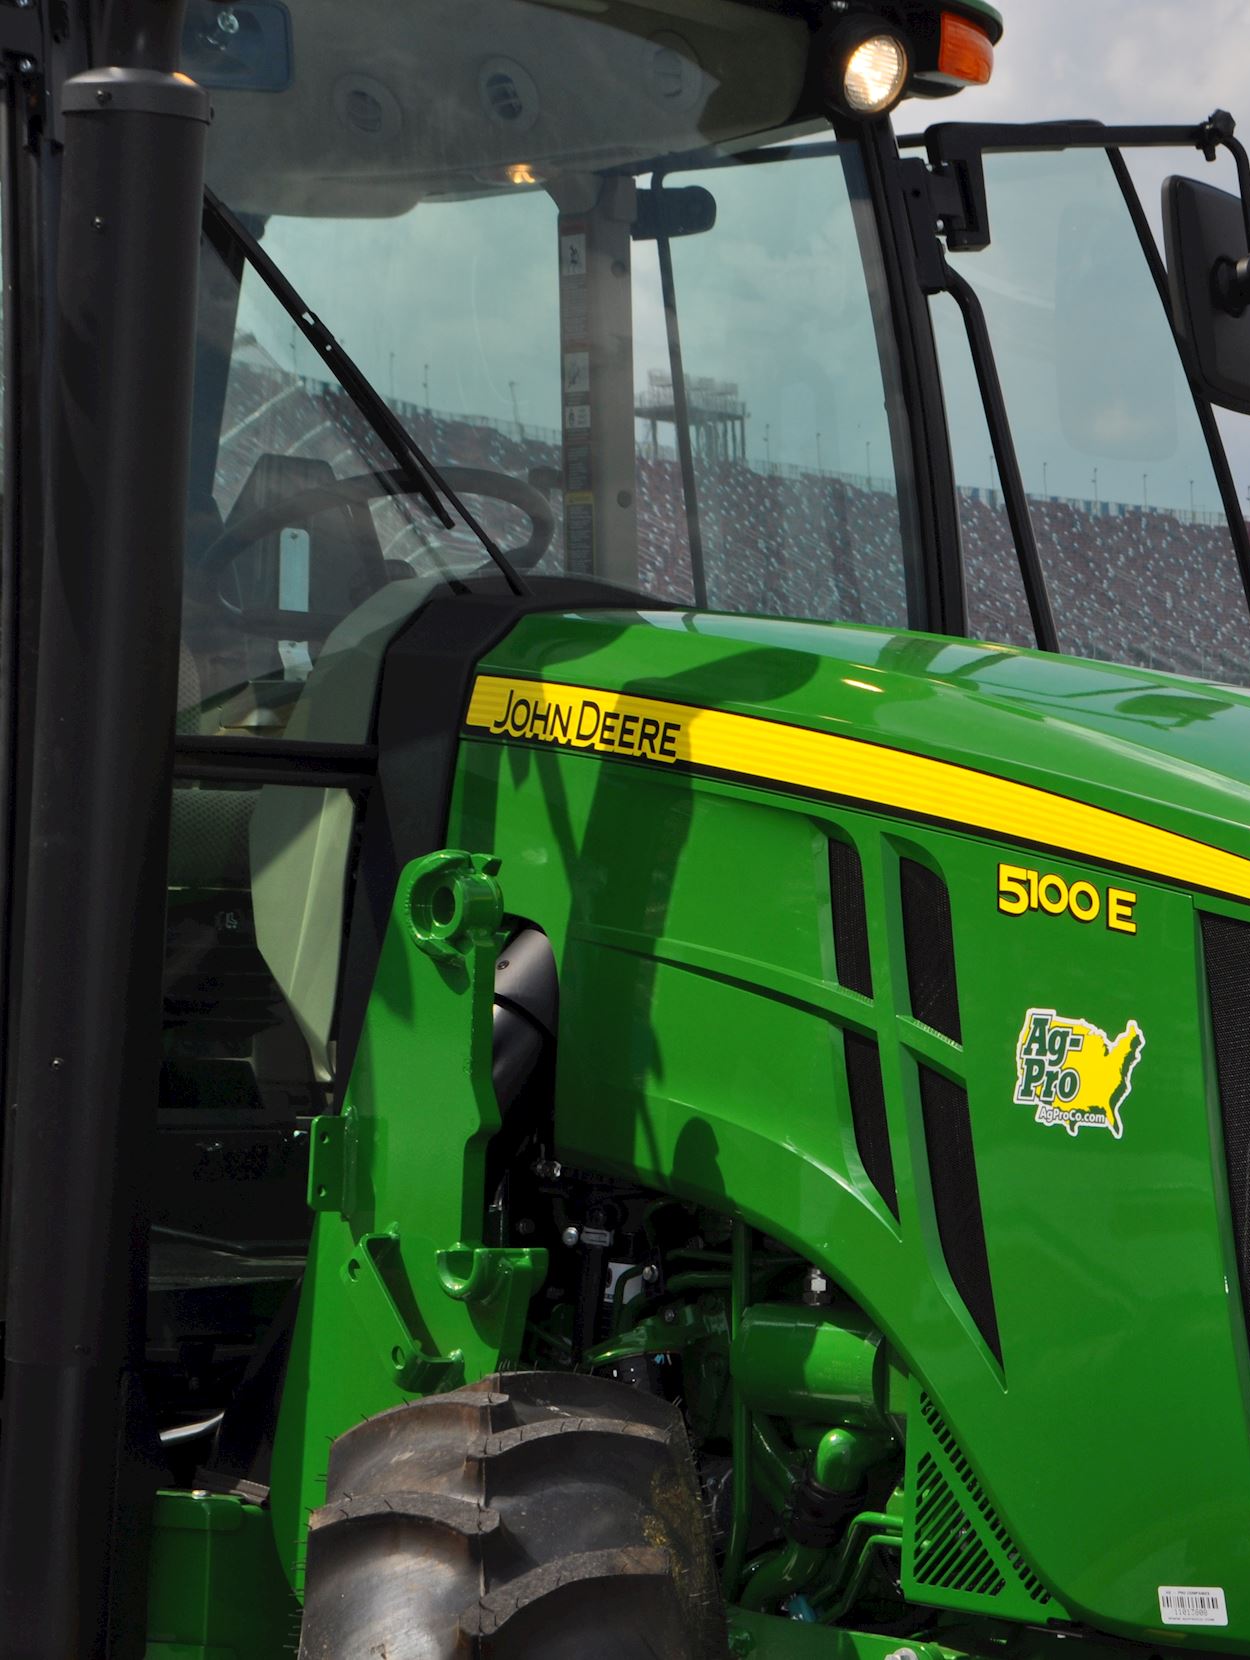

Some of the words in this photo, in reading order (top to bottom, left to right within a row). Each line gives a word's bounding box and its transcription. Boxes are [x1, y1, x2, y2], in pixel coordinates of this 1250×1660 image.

[494, 689, 572, 738] JOHN
[576, 699, 682, 758] DEERE
[998, 863, 1100, 924] 5100
[1107, 886, 1137, 936] E
[1021, 1015, 1082, 1066] Ag-
[1019, 1058, 1080, 1101] Pro
[1038, 1106, 1106, 1124] AgProCo.com
